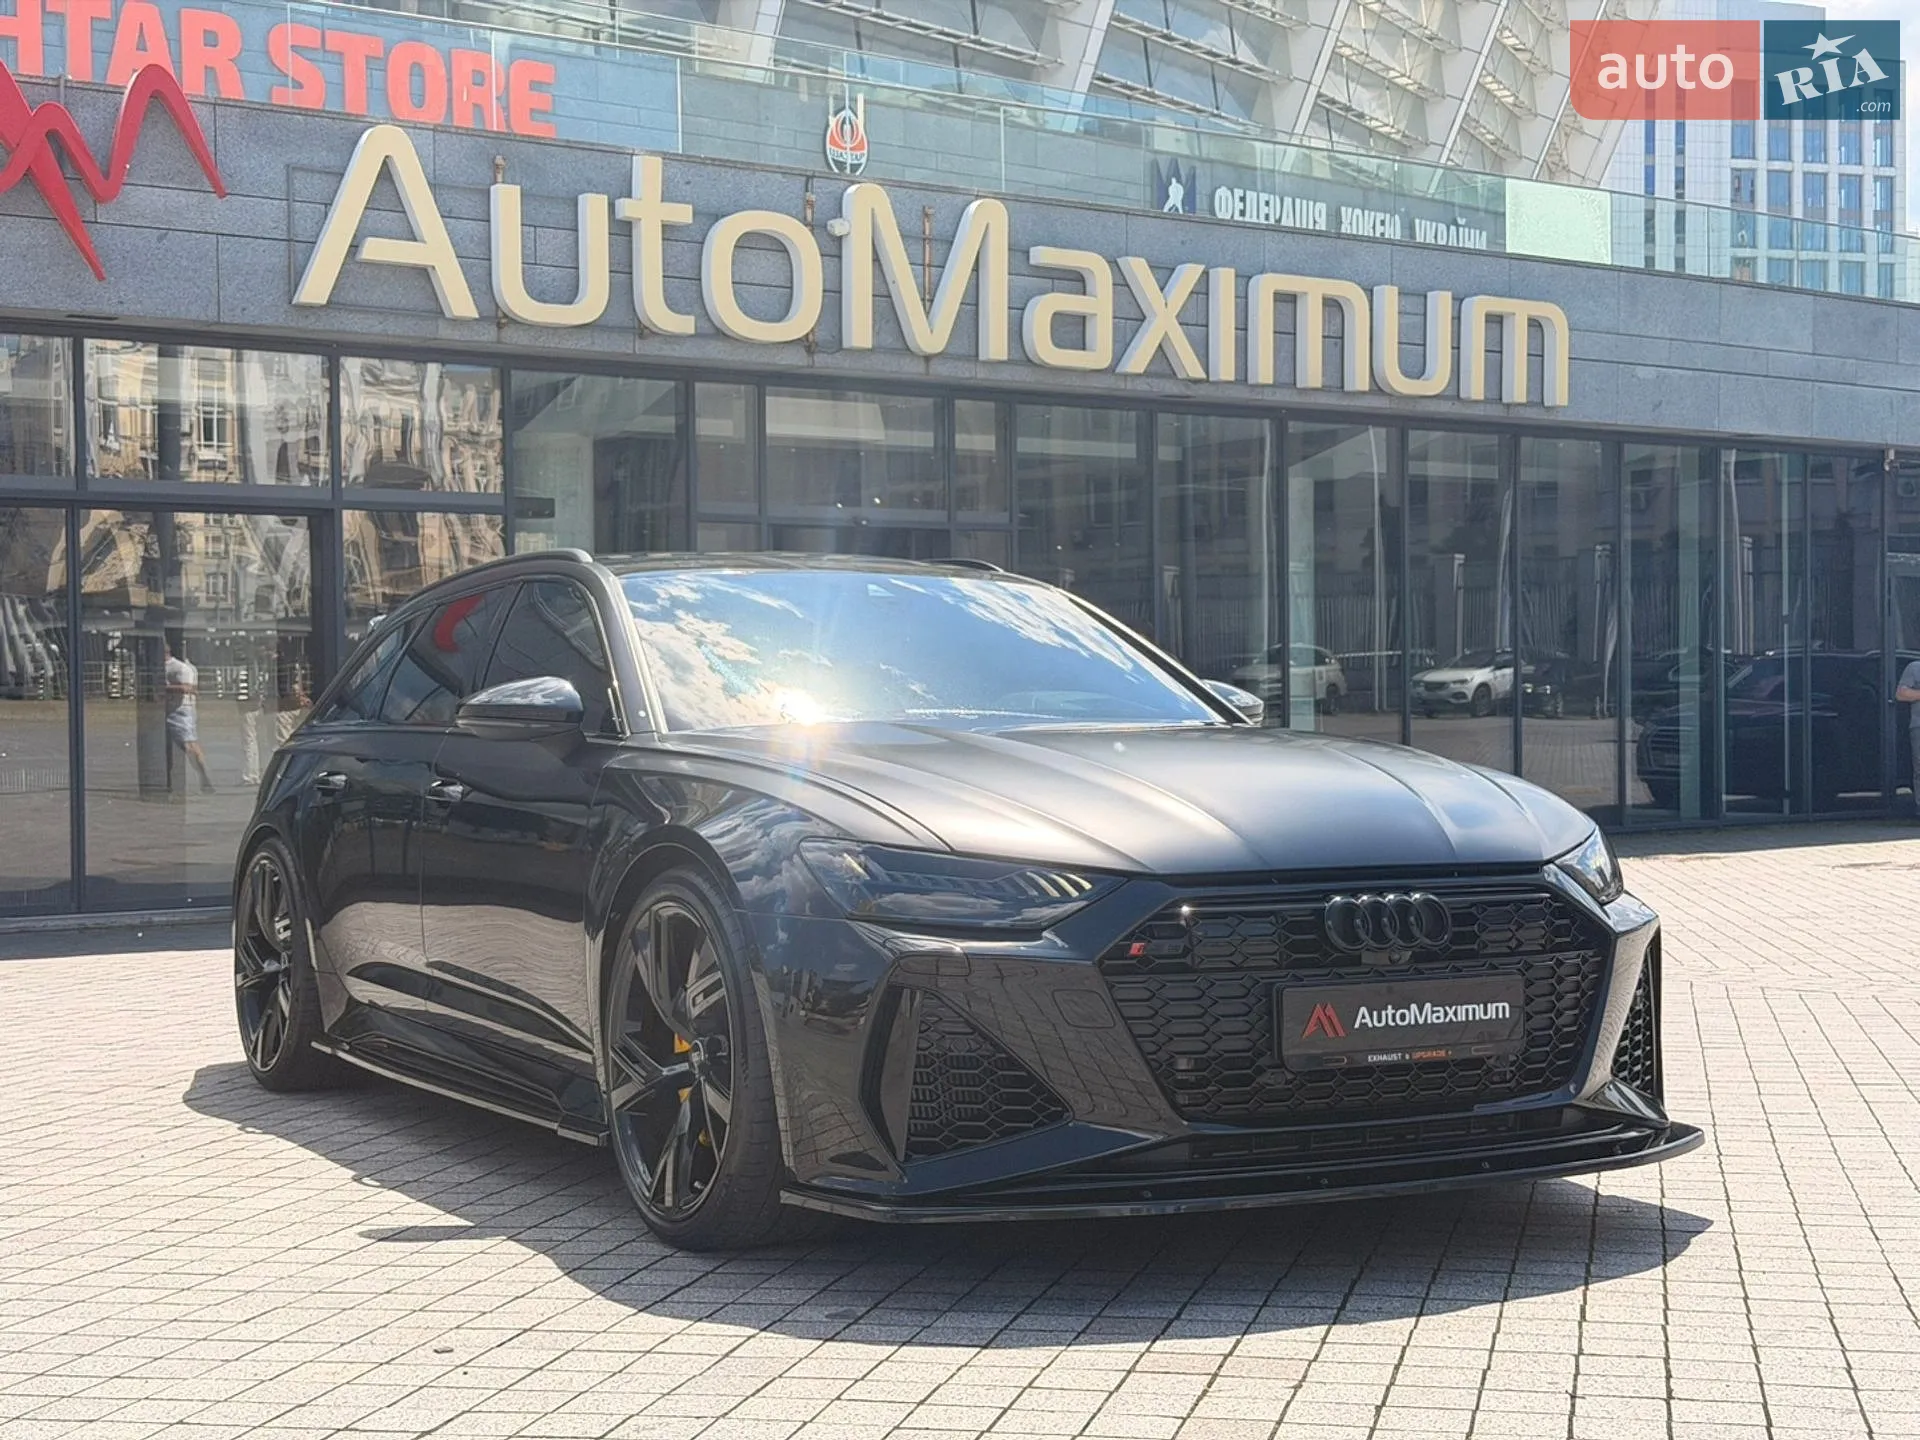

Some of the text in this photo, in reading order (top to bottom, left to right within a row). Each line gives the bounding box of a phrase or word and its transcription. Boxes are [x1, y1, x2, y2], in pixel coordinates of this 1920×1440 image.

[268, 23, 557, 138] STORE
[292, 124, 1570, 408] AutoMaximum
[1354, 1002, 1510, 1029] AutoMaximum
[1367, 1053, 1402, 1062] EXHAUST
